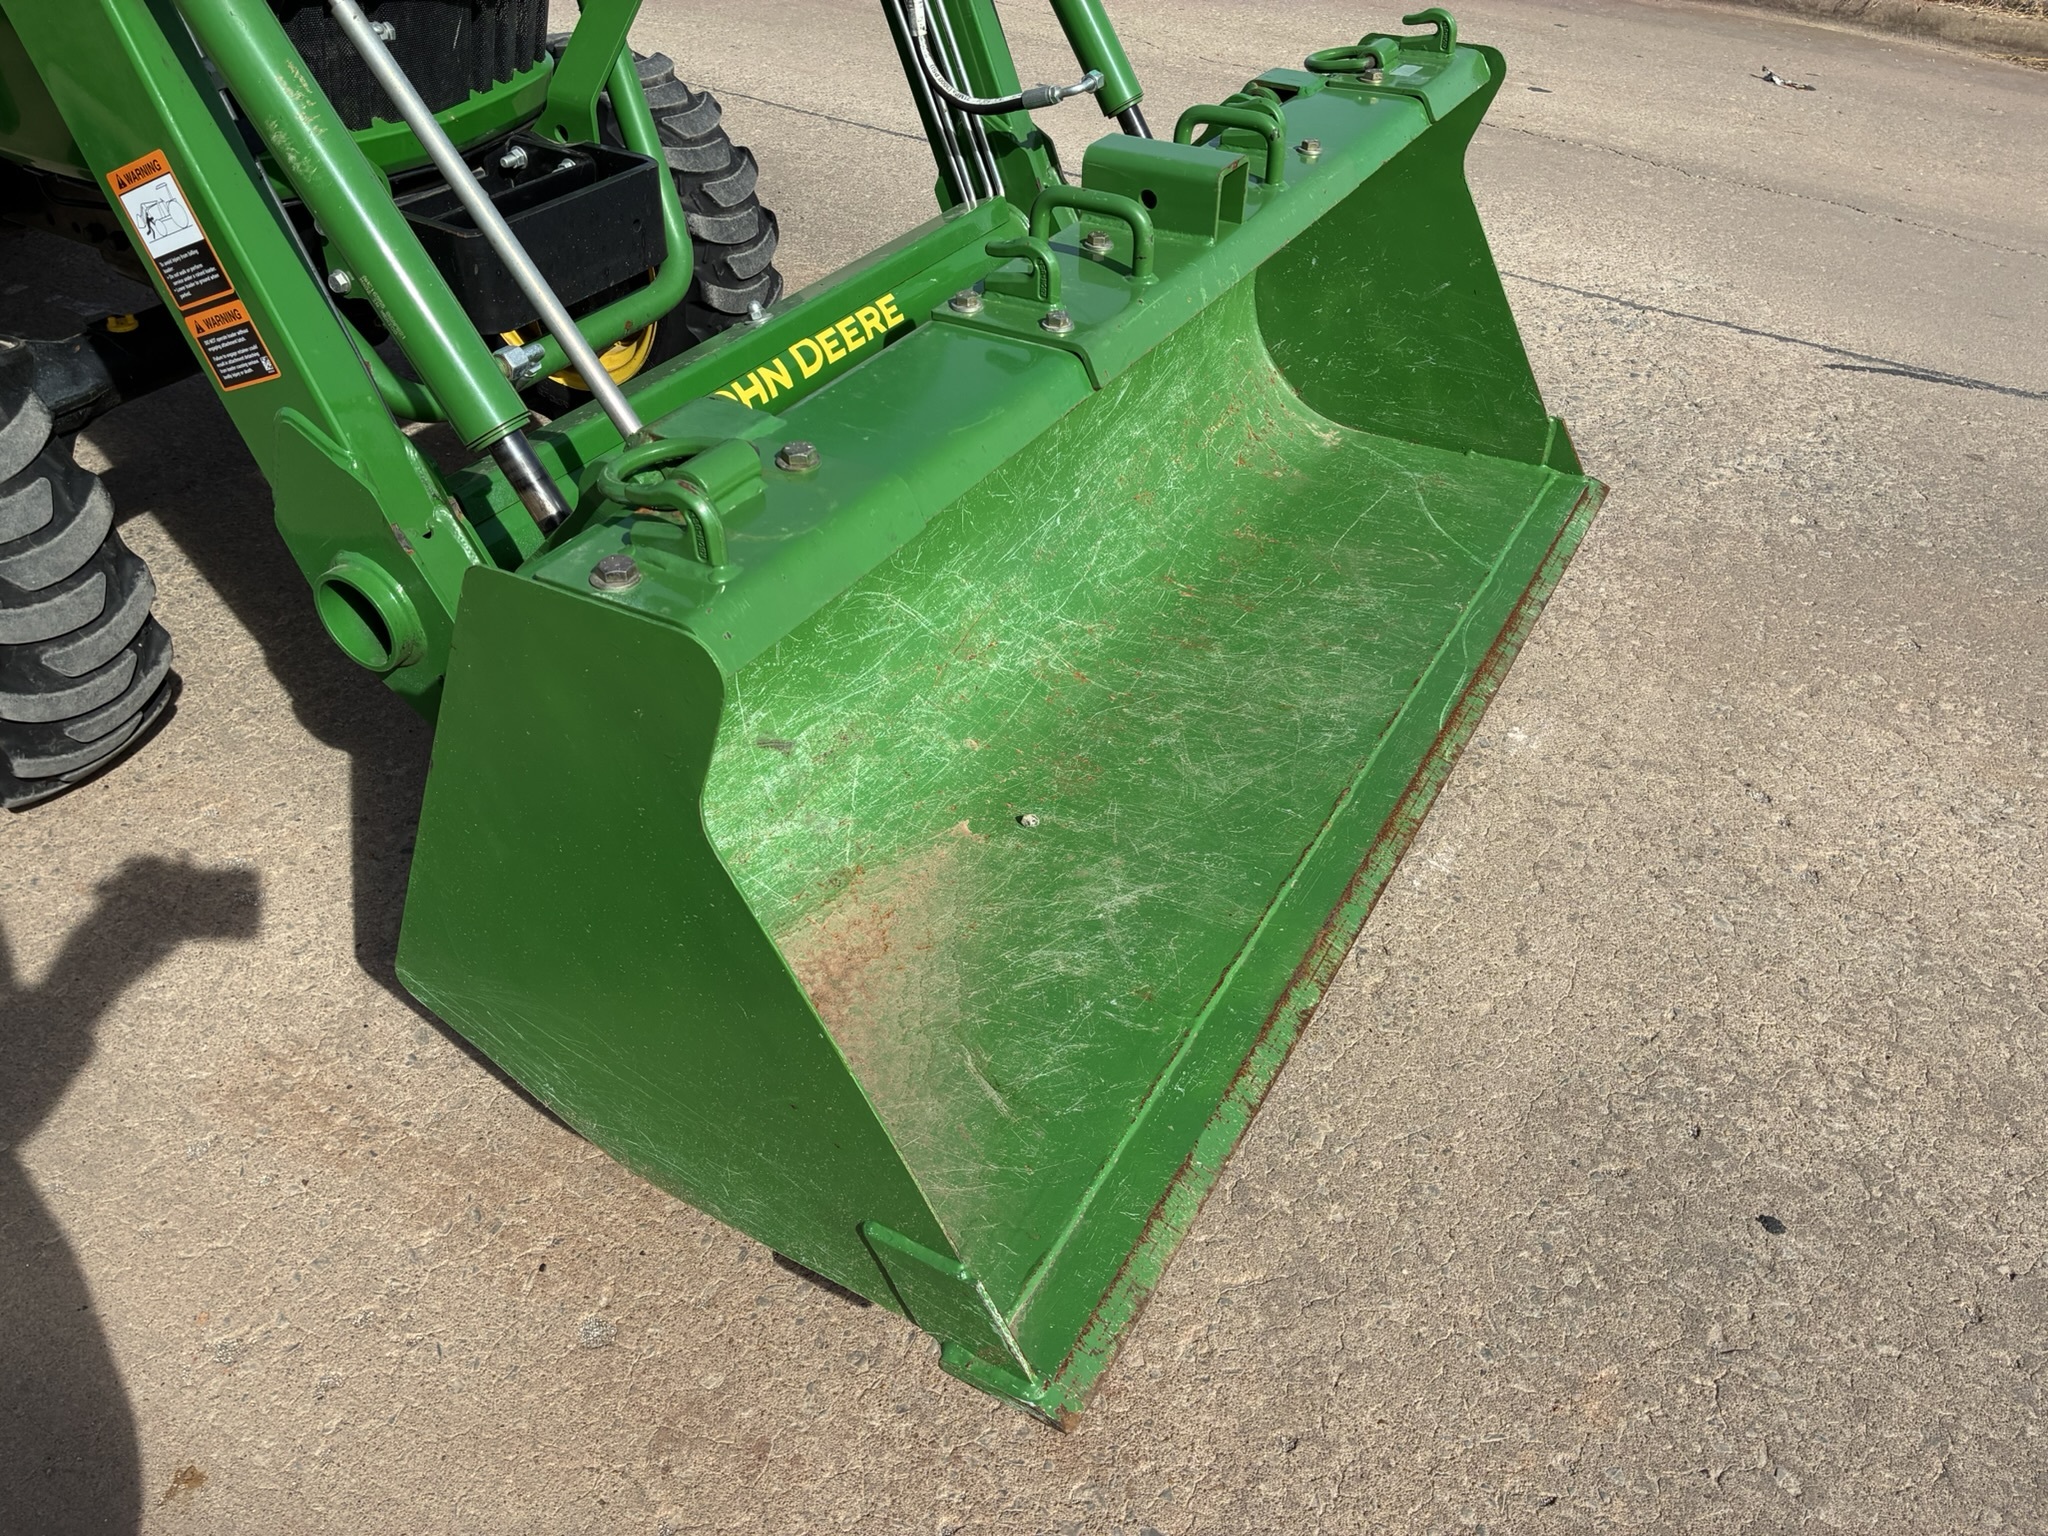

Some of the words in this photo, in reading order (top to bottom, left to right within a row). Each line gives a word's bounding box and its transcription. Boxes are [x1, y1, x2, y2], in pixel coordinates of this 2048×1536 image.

[123, 160, 162, 184] WARNING
[203, 308, 242, 330] WARNING
[788, 293, 905, 380] DEERE
